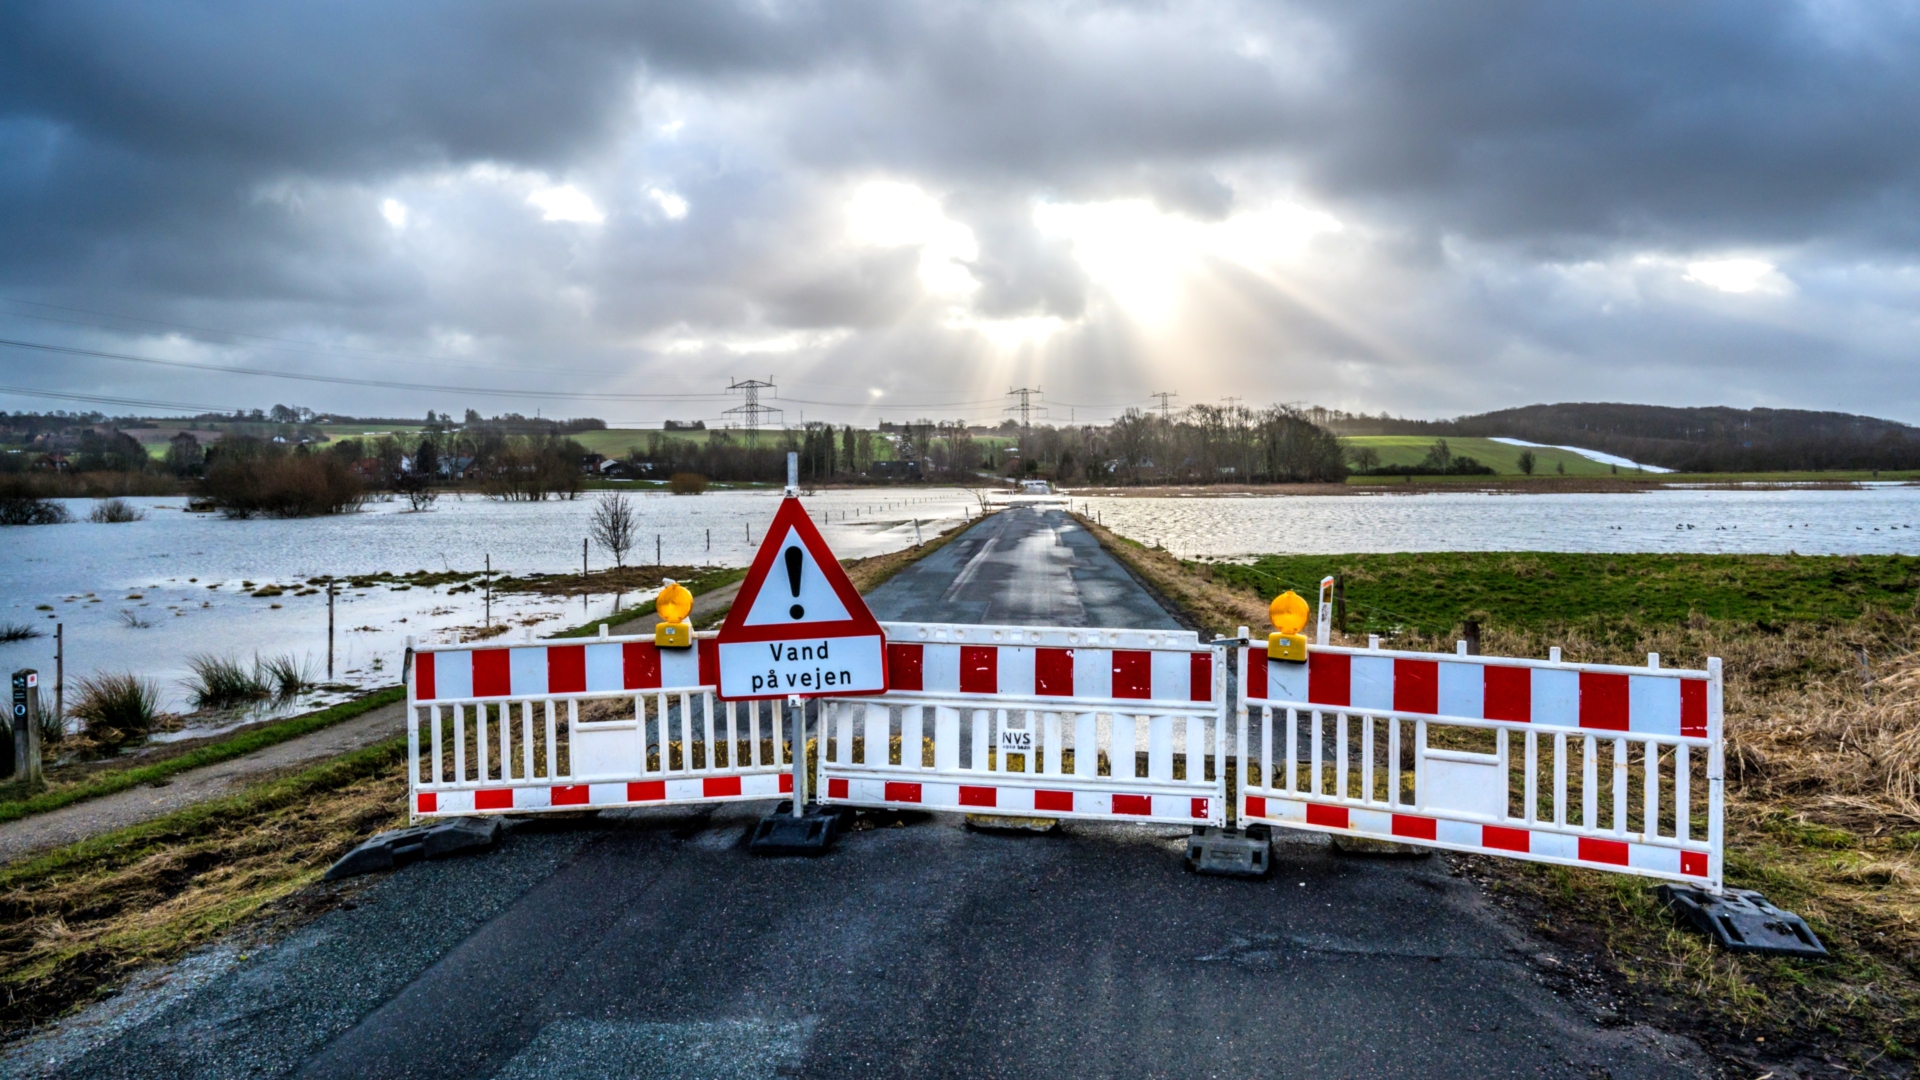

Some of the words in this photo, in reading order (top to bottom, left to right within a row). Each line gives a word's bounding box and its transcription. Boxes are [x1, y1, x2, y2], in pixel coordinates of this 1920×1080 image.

[770, 641, 828, 661] Vand
[752, 670, 778, 692] på
[786, 668, 851, 690] vejen
[1002, 732, 1031, 744] NVS
